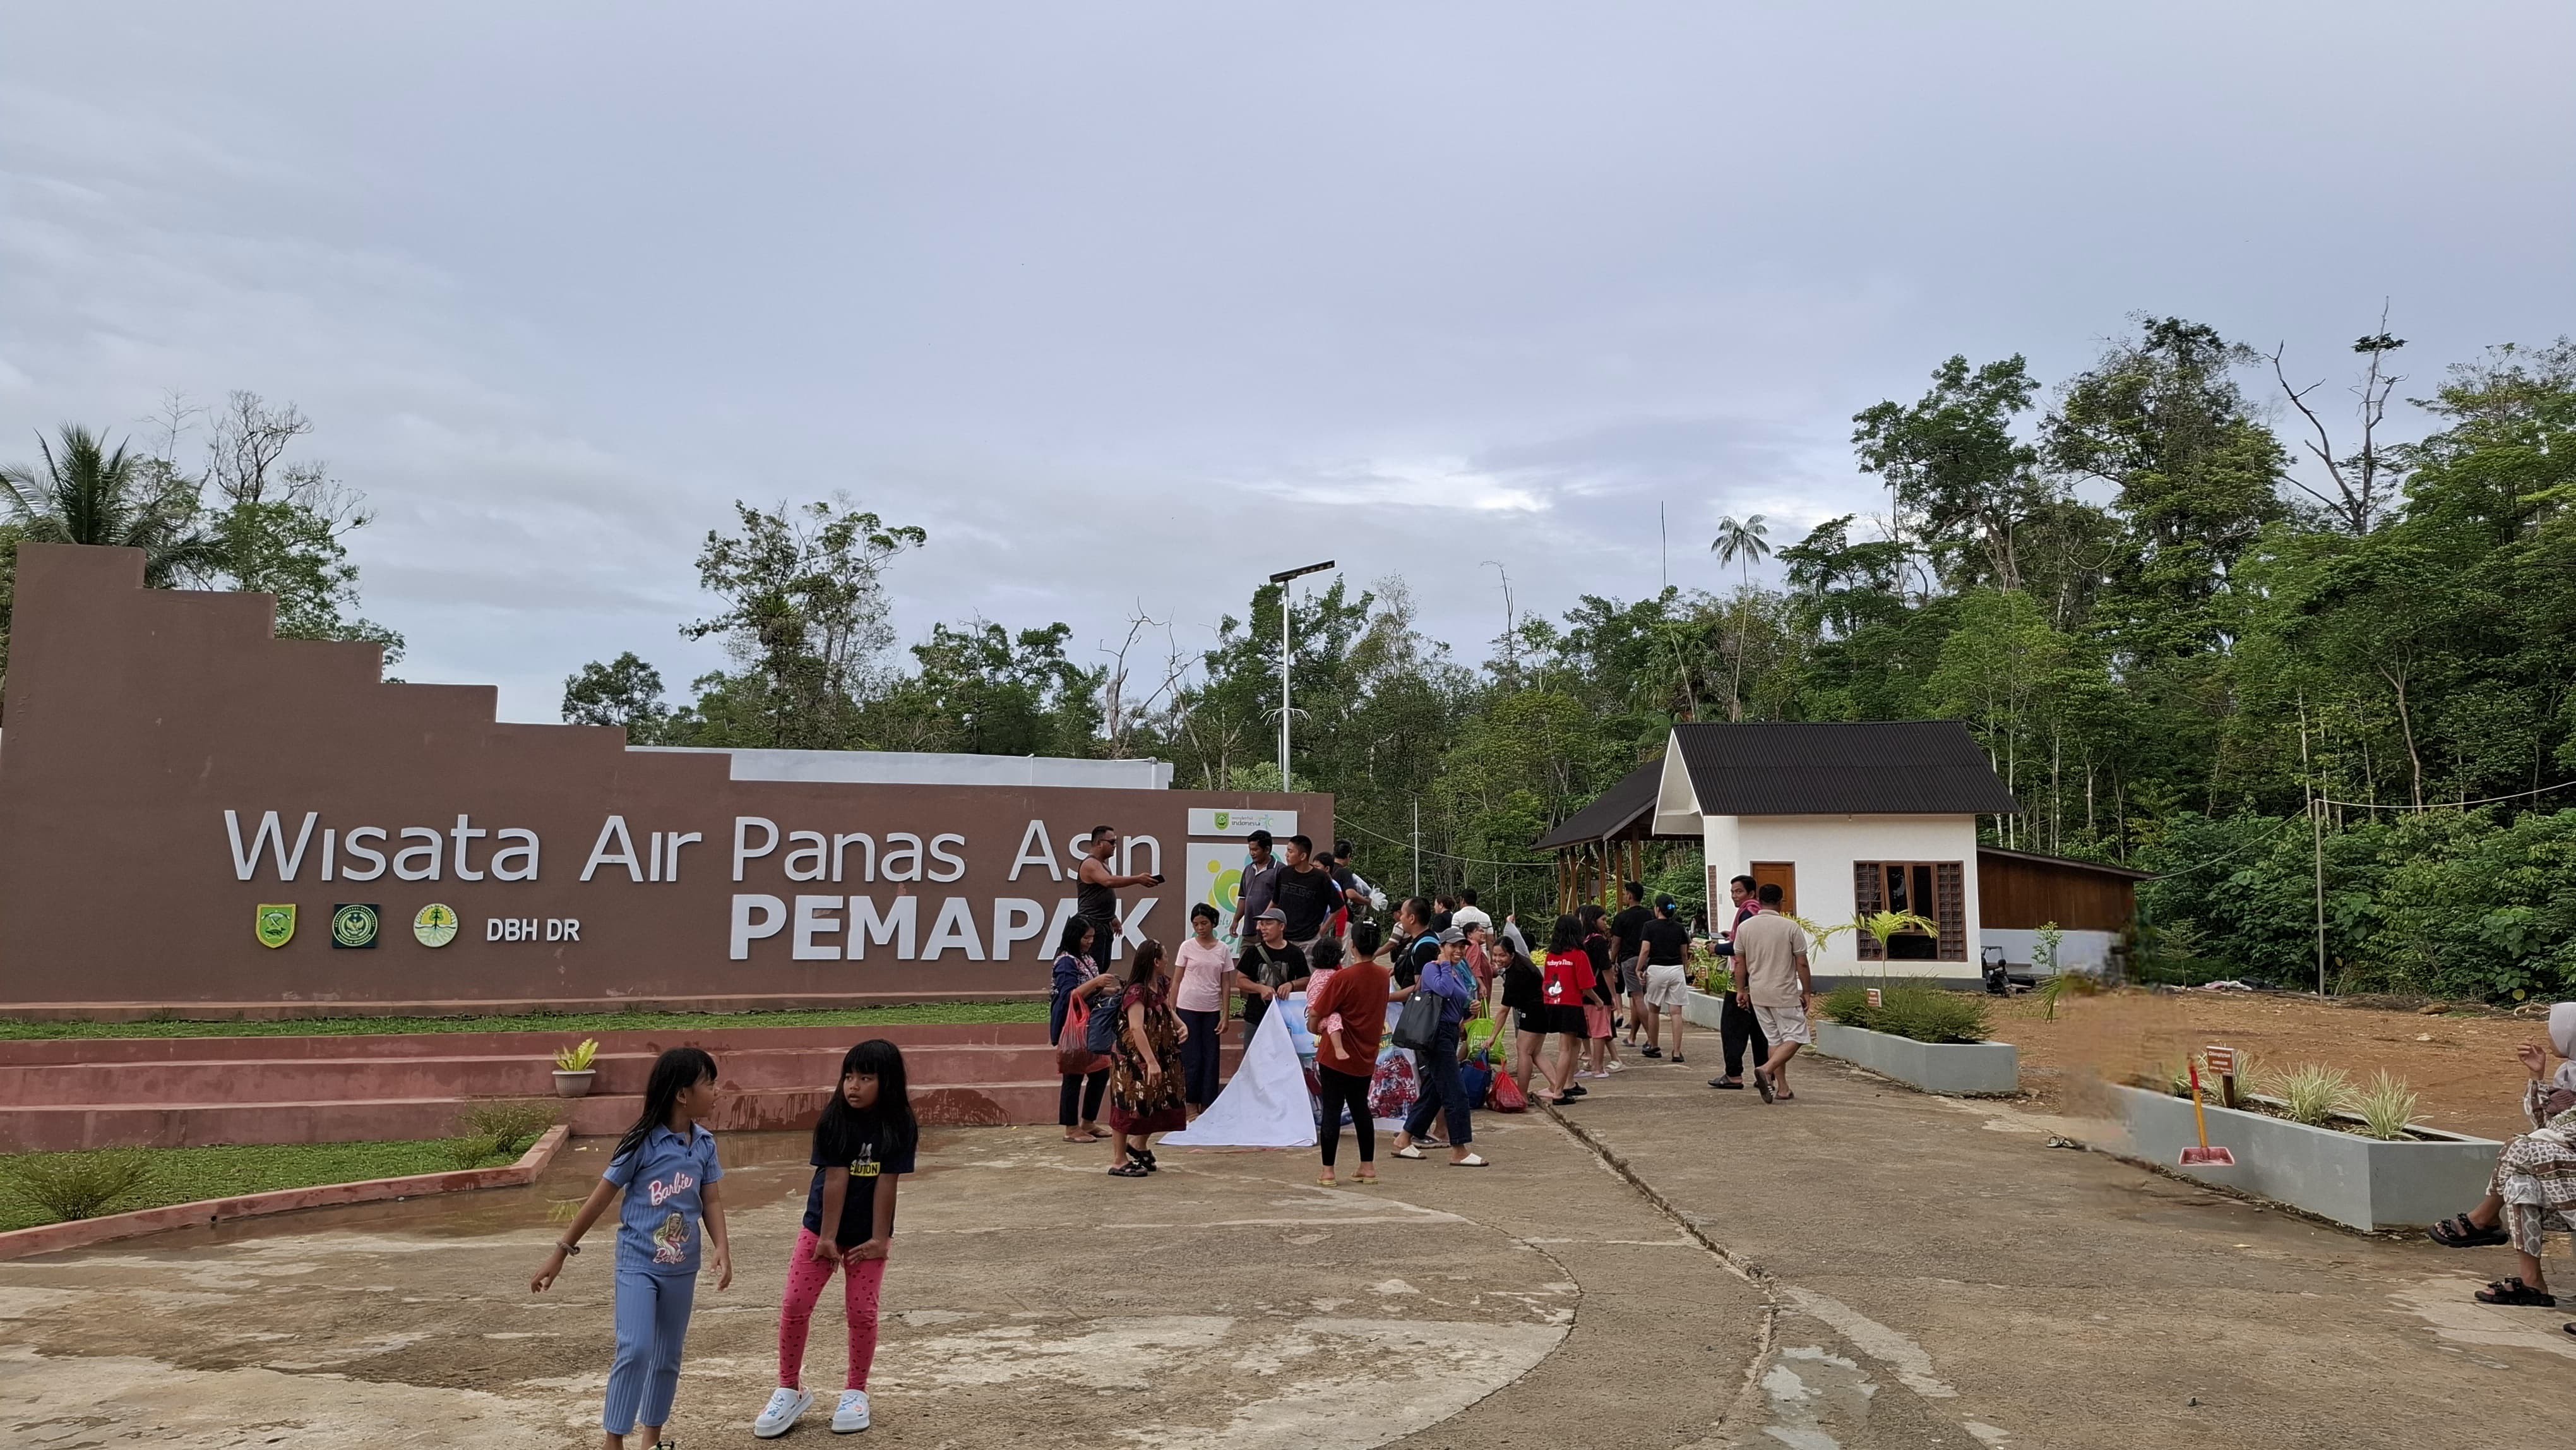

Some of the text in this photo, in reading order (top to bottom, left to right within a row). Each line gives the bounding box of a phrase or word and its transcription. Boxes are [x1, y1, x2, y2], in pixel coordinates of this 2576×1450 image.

[224, 810, 539, 881] Wisata
[579, 815, 702, 882] Air
[732, 816, 965, 882] Panas
[487, 918, 580, 941] DBH DR
[849, 1163, 878, 1175] CAUTON
[648, 1171, 693, 1206] Barbie
